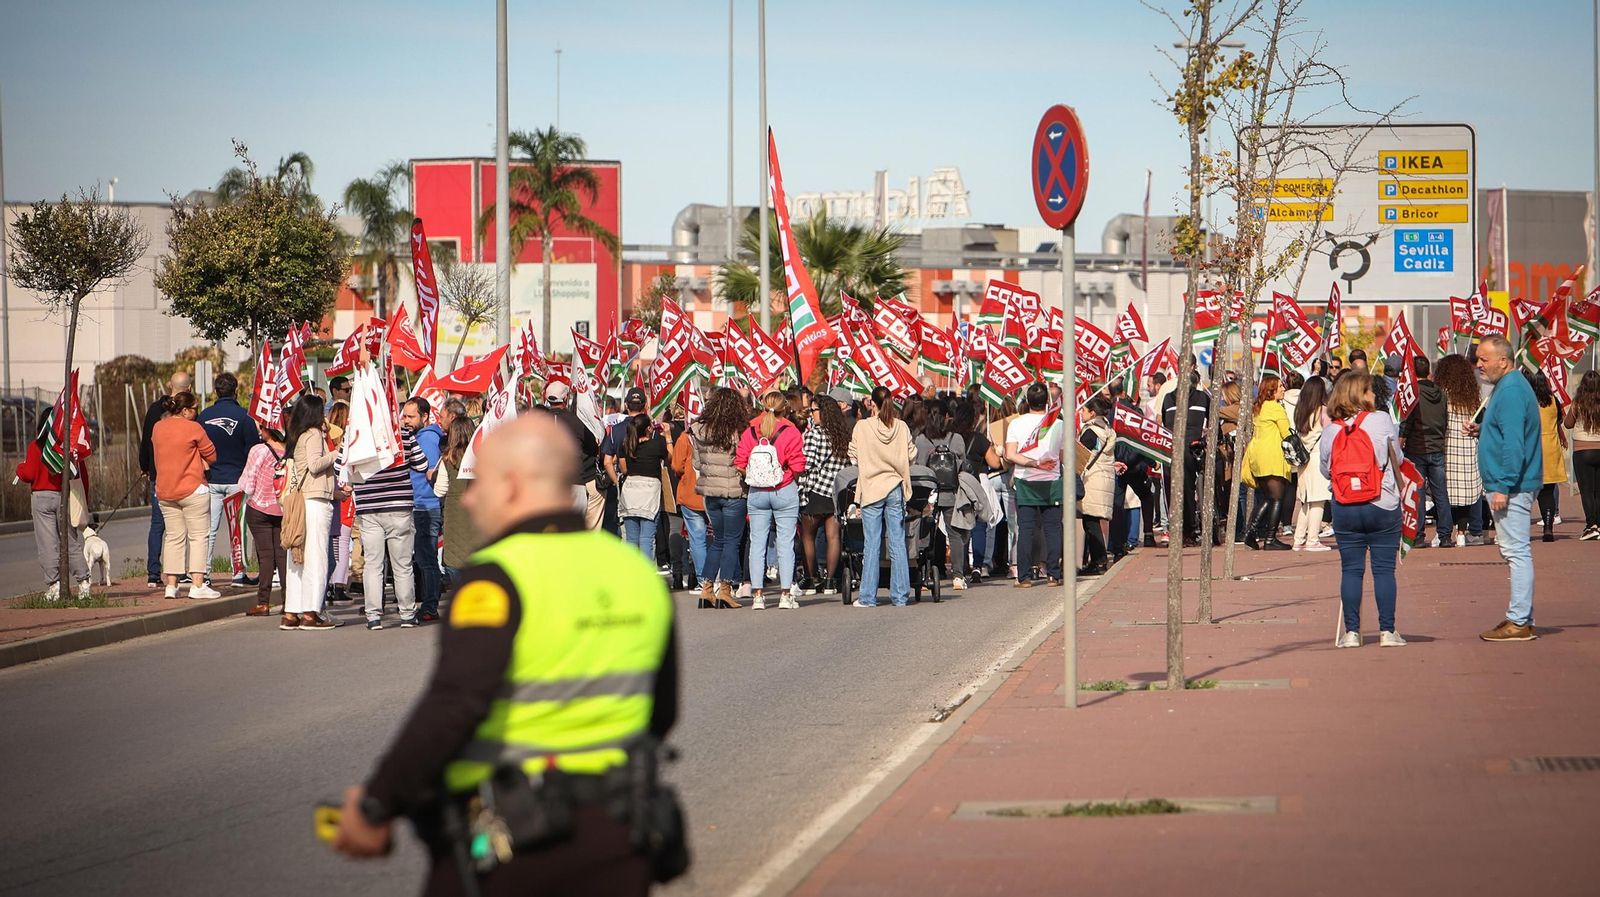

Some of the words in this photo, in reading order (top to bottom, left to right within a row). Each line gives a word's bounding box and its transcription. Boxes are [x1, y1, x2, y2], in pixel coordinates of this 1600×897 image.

[1402, 156, 1444, 169] IKEA
[1402, 185, 1463, 194] Decathlon
[1402, 209, 1439, 219] Bricor
[1399, 244, 1449, 256] Sevilla
[1403, 258, 1445, 270] Cadiz
[537, 279, 582, 287] Bnvenido
[551, 289, 590, 299] Shopping
[988, 369, 1012, 390] Cádiz
[1141, 432, 1173, 450] Cádiz
